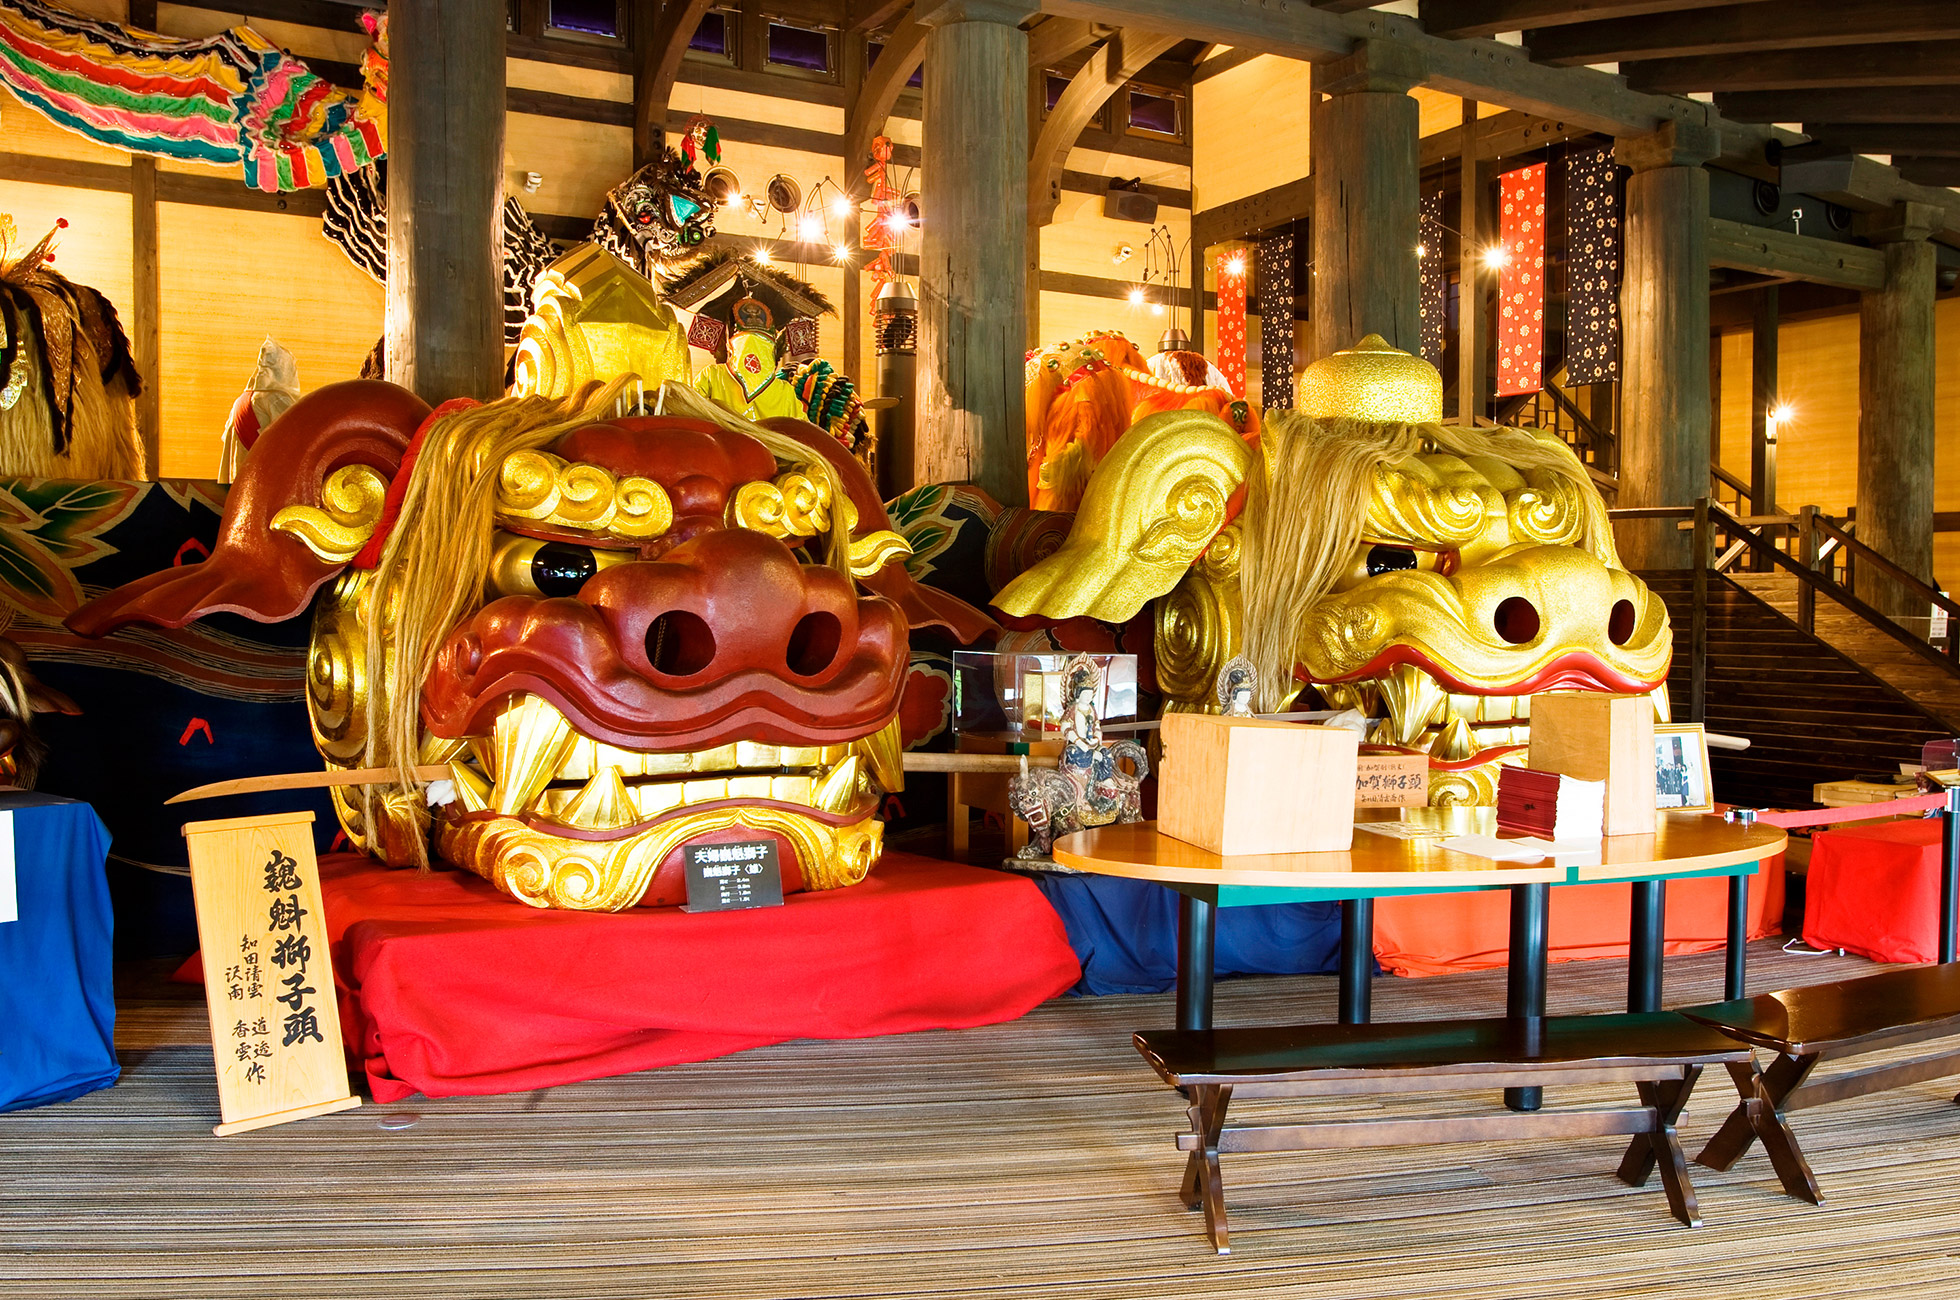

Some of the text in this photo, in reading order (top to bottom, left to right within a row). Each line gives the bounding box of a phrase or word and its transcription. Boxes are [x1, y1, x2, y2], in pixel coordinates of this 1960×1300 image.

[263, 850, 324, 1047] 巍魁獅子頭
